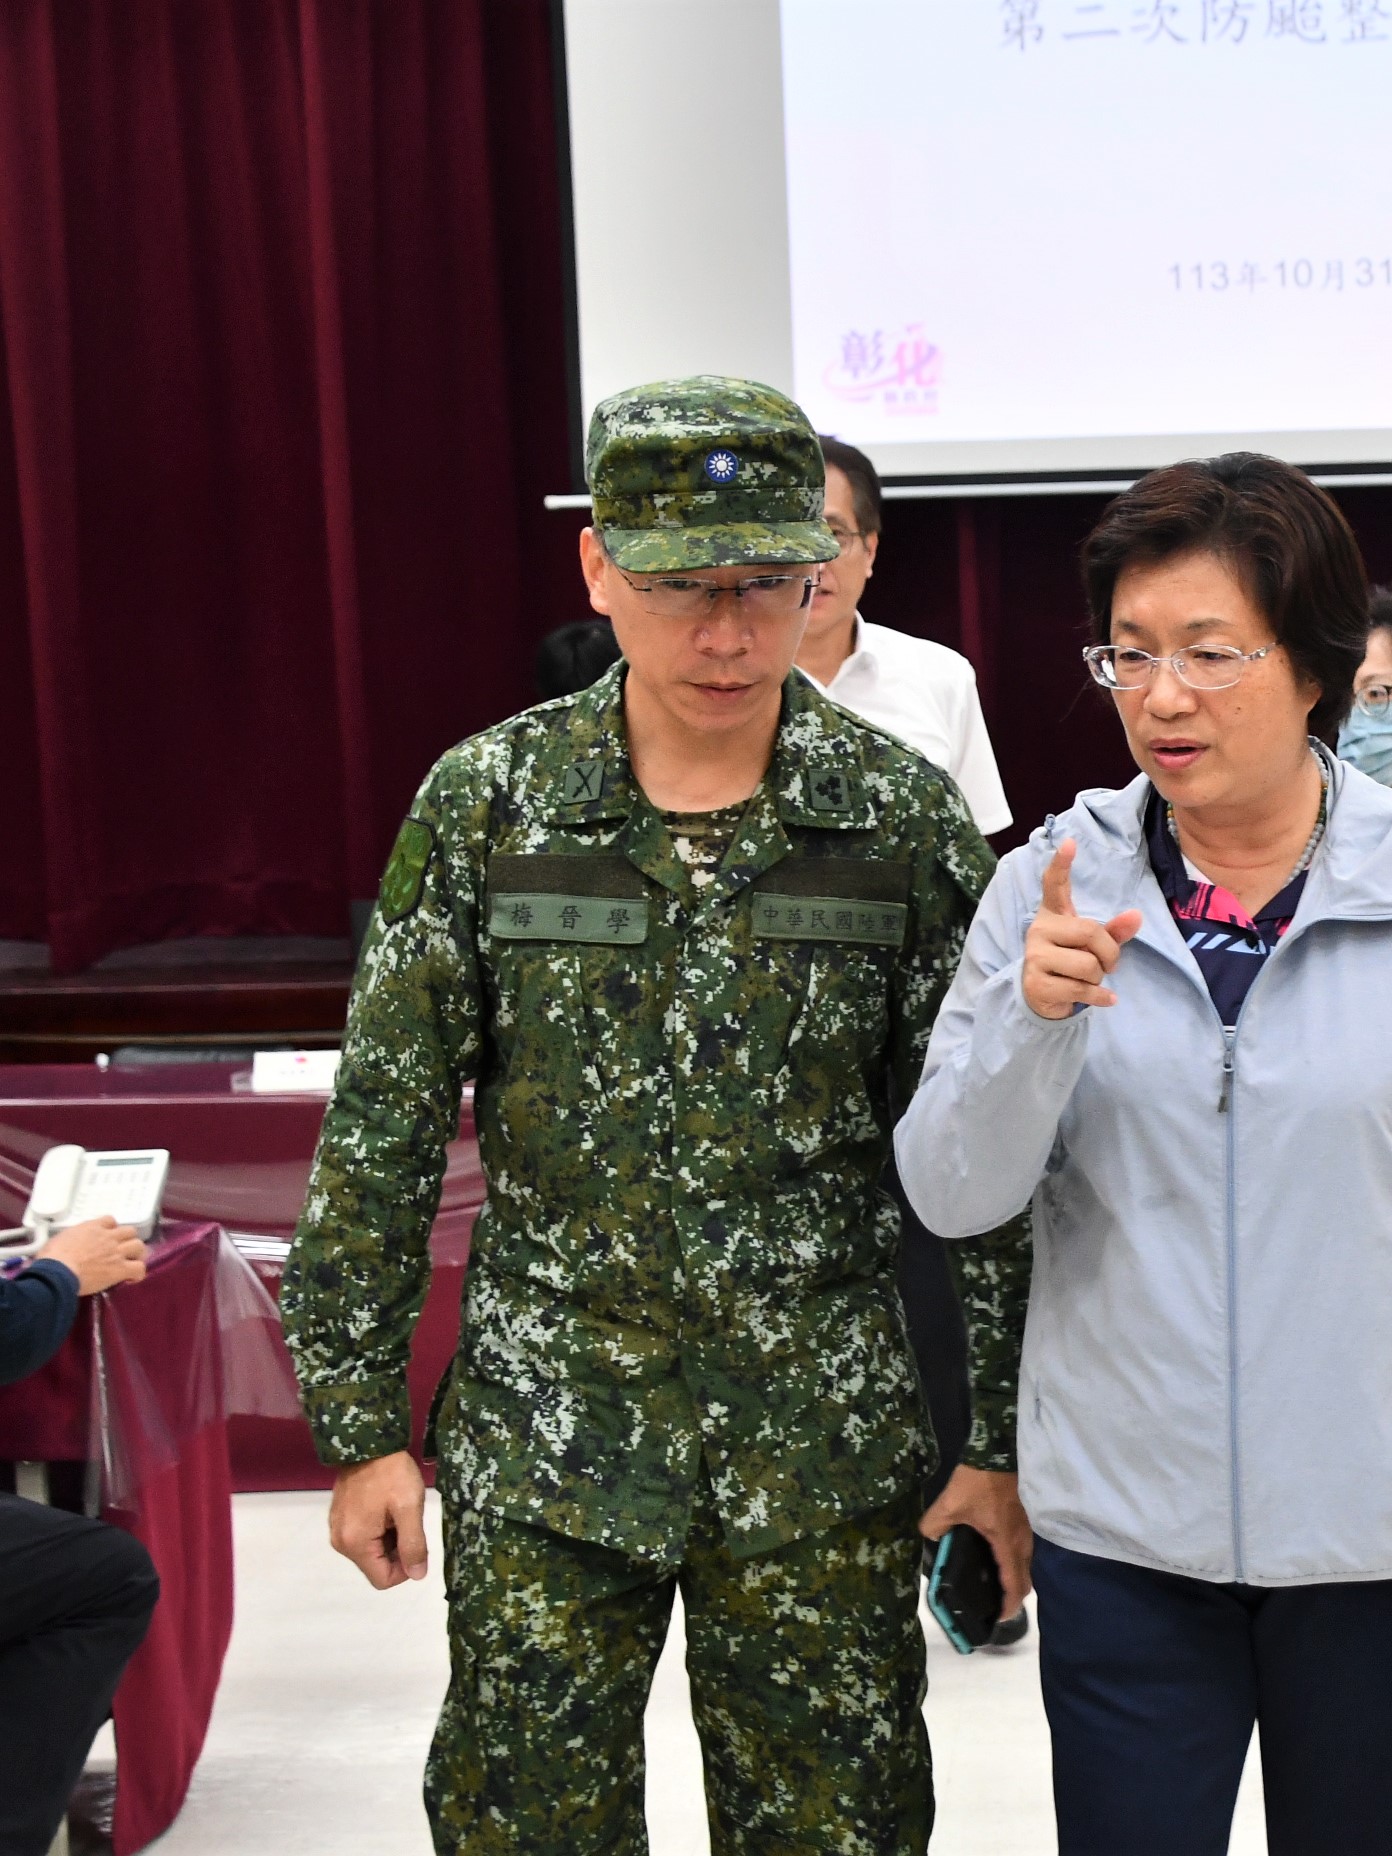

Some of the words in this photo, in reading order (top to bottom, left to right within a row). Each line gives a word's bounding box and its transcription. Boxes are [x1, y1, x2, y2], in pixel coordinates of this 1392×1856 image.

[763, 905, 897, 933] 中華民國陸軍
